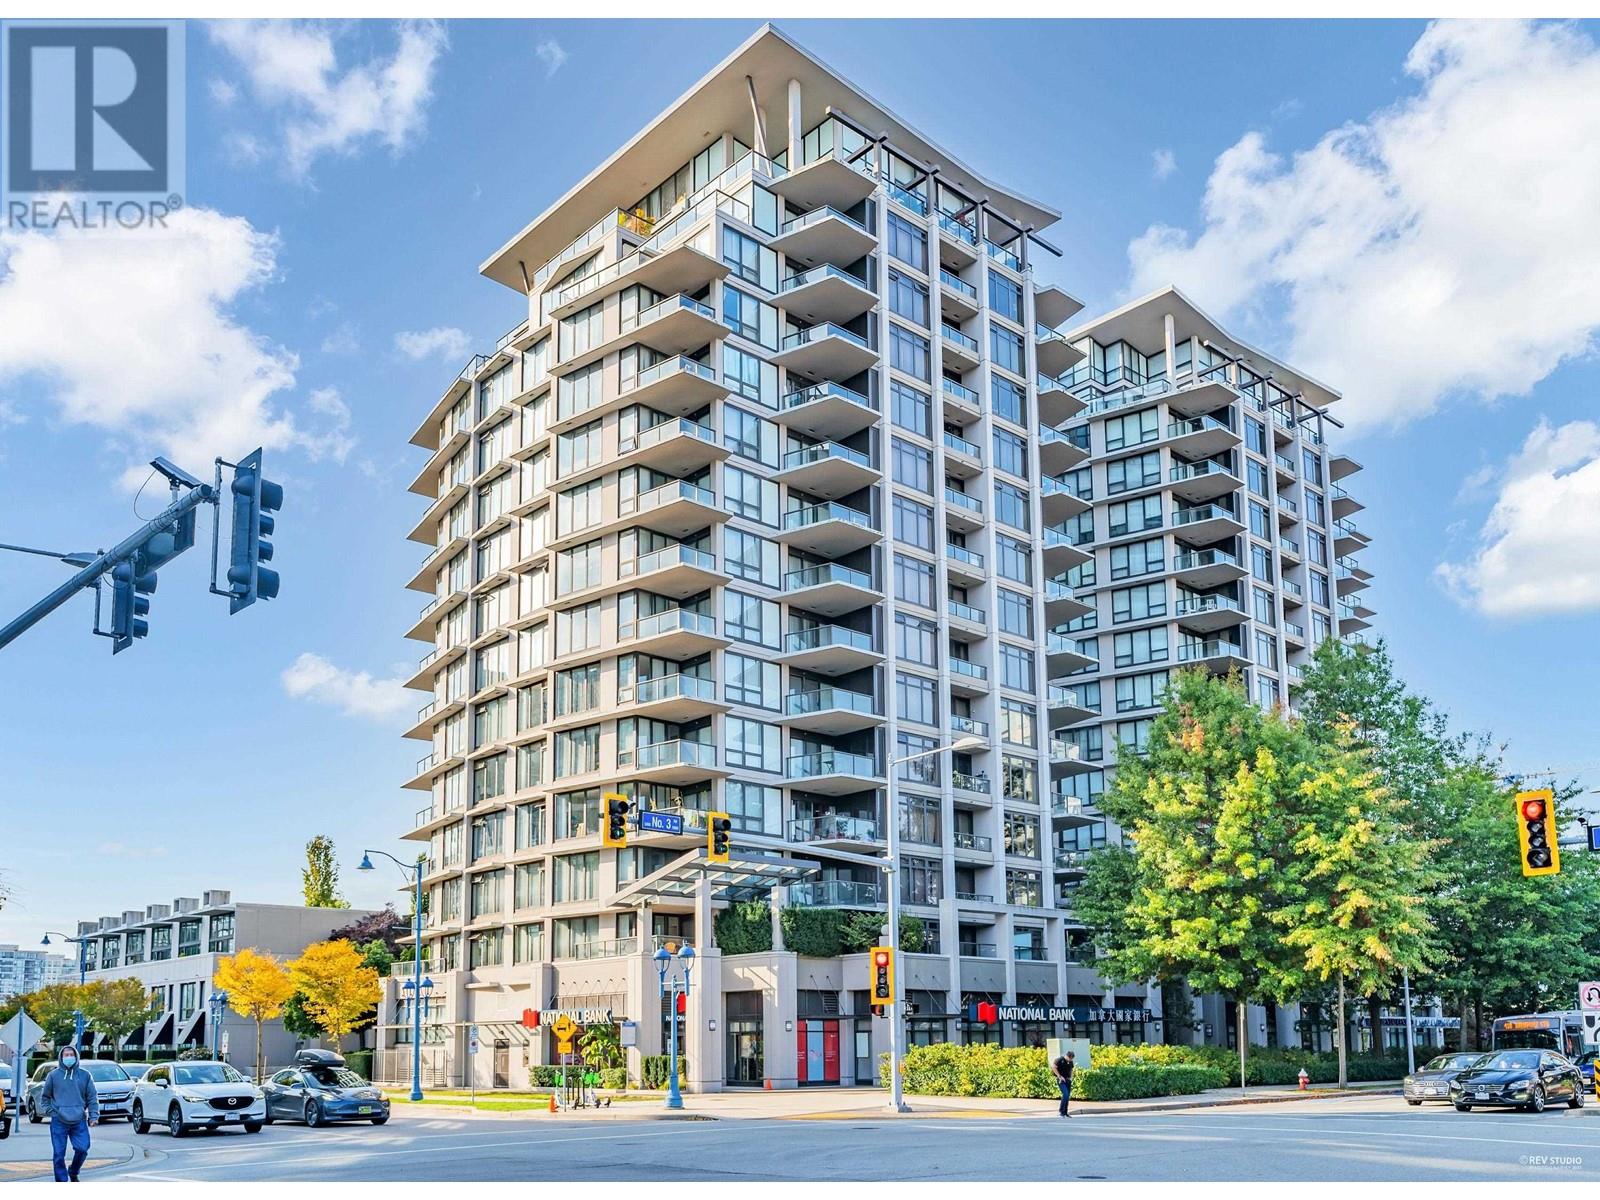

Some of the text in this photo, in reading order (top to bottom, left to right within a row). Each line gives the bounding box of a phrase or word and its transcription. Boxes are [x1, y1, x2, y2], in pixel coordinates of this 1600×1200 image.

[652, 816, 664, 829] No.
[666, 818, 672, 830] 3
[584, 1009, 610, 1024] BANK
[999, 1007, 1075, 1021] NATIONAL BANK
[1089, 1008, 1150, 1022] 加拿大國家銀行
